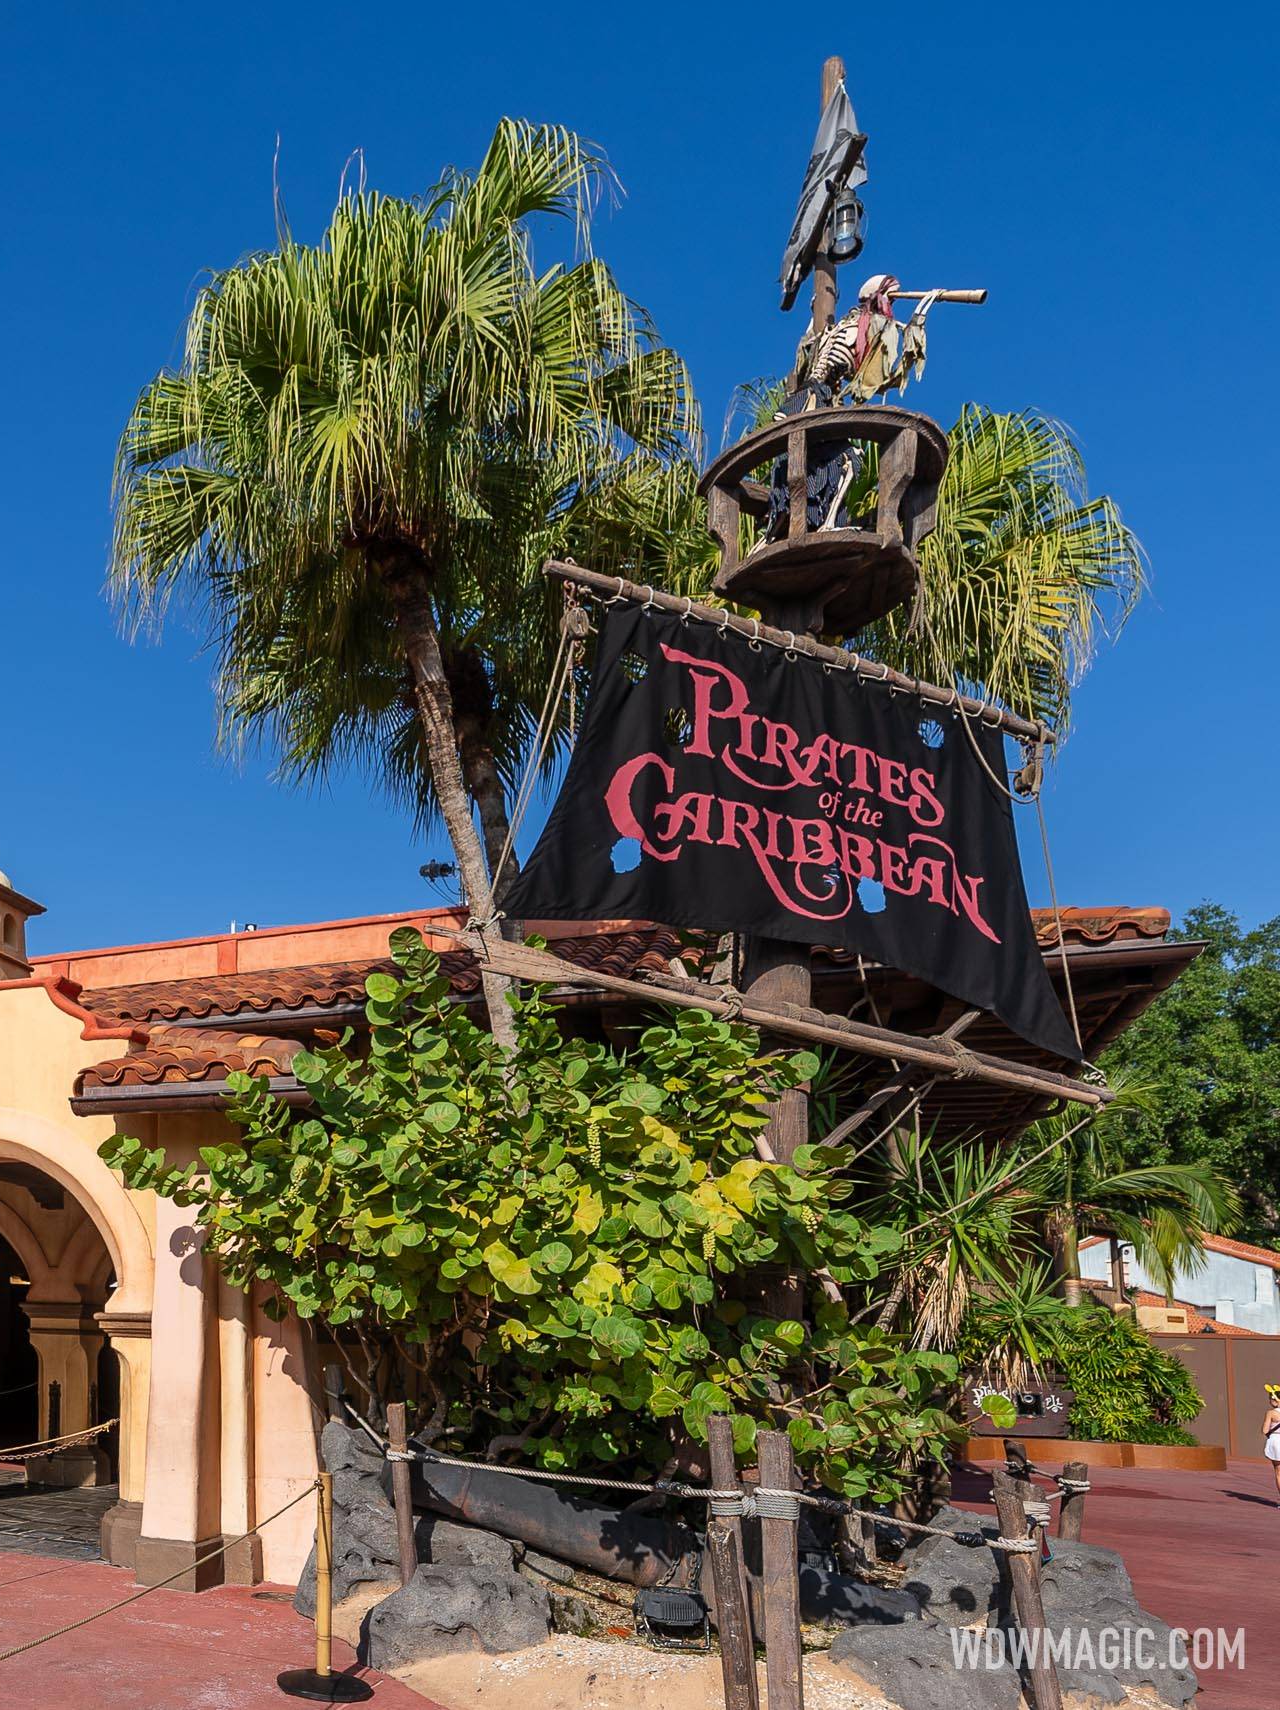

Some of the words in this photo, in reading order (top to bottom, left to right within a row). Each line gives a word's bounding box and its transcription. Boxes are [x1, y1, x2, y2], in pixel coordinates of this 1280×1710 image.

[660, 642, 945, 827] PIRATES
[818, 790, 842, 817] of
[844, 797, 884, 828] the
[604, 752, 1002, 944] CARIBBEAN
